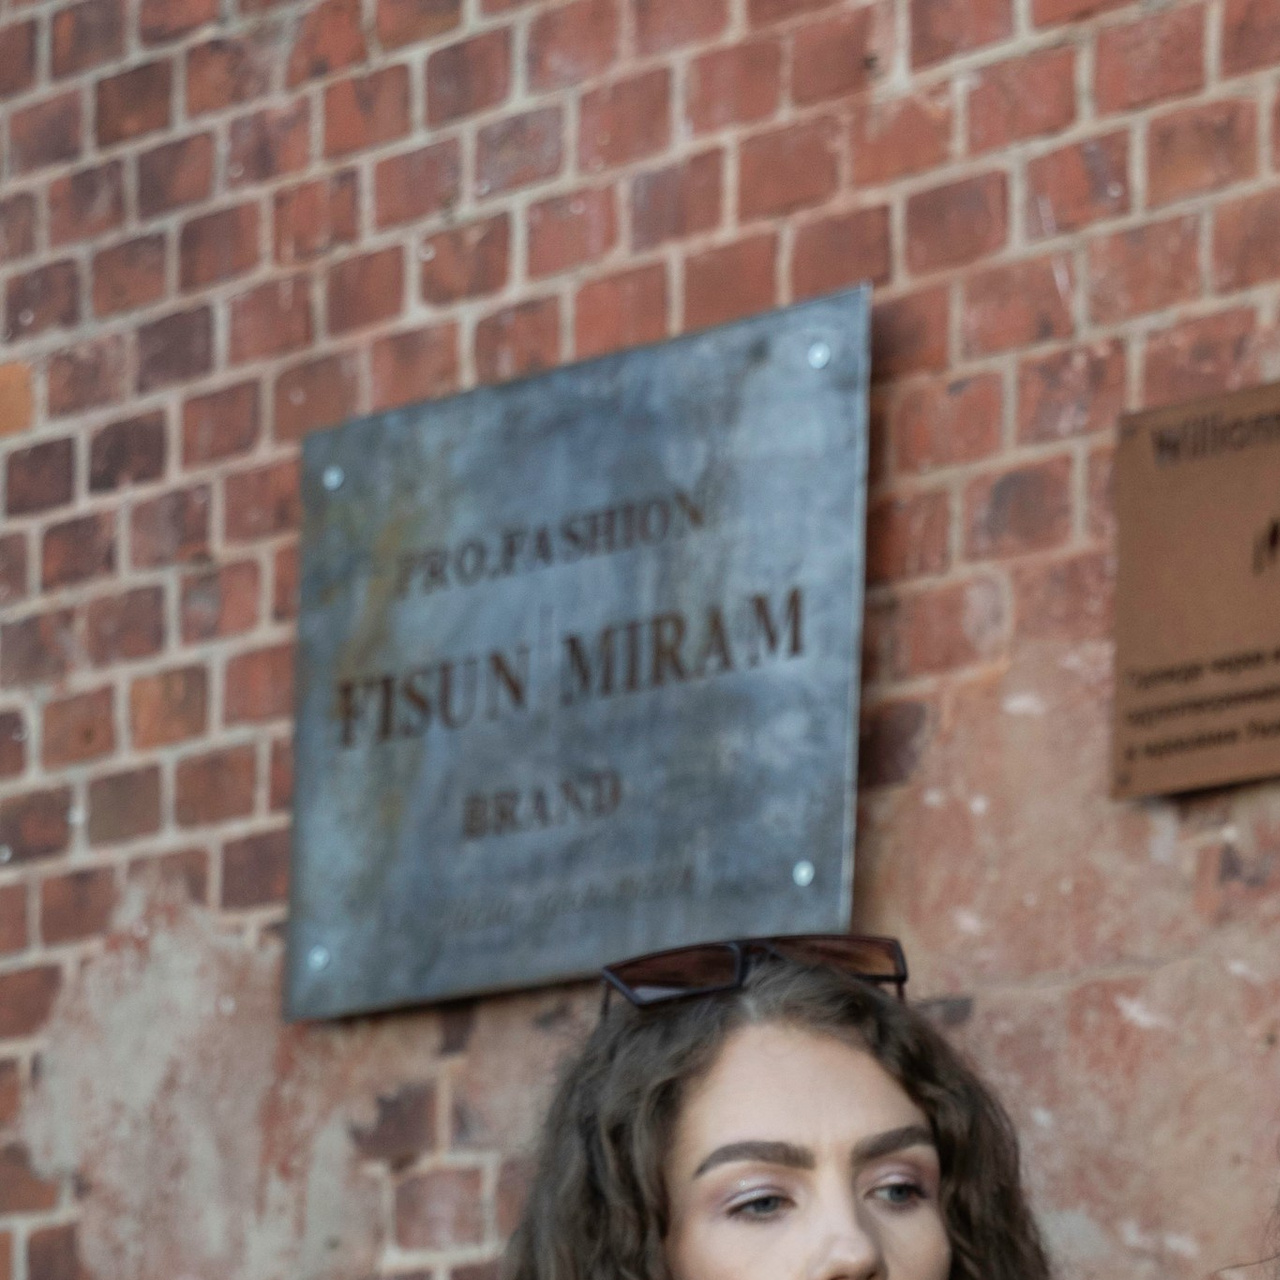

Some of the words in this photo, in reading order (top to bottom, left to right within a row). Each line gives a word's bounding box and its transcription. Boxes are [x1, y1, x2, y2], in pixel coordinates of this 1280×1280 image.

[338, 643, 532, 750] FISUN
[559, 586, 806, 707] MIRAM
[461, 767, 622, 841] BRAND
